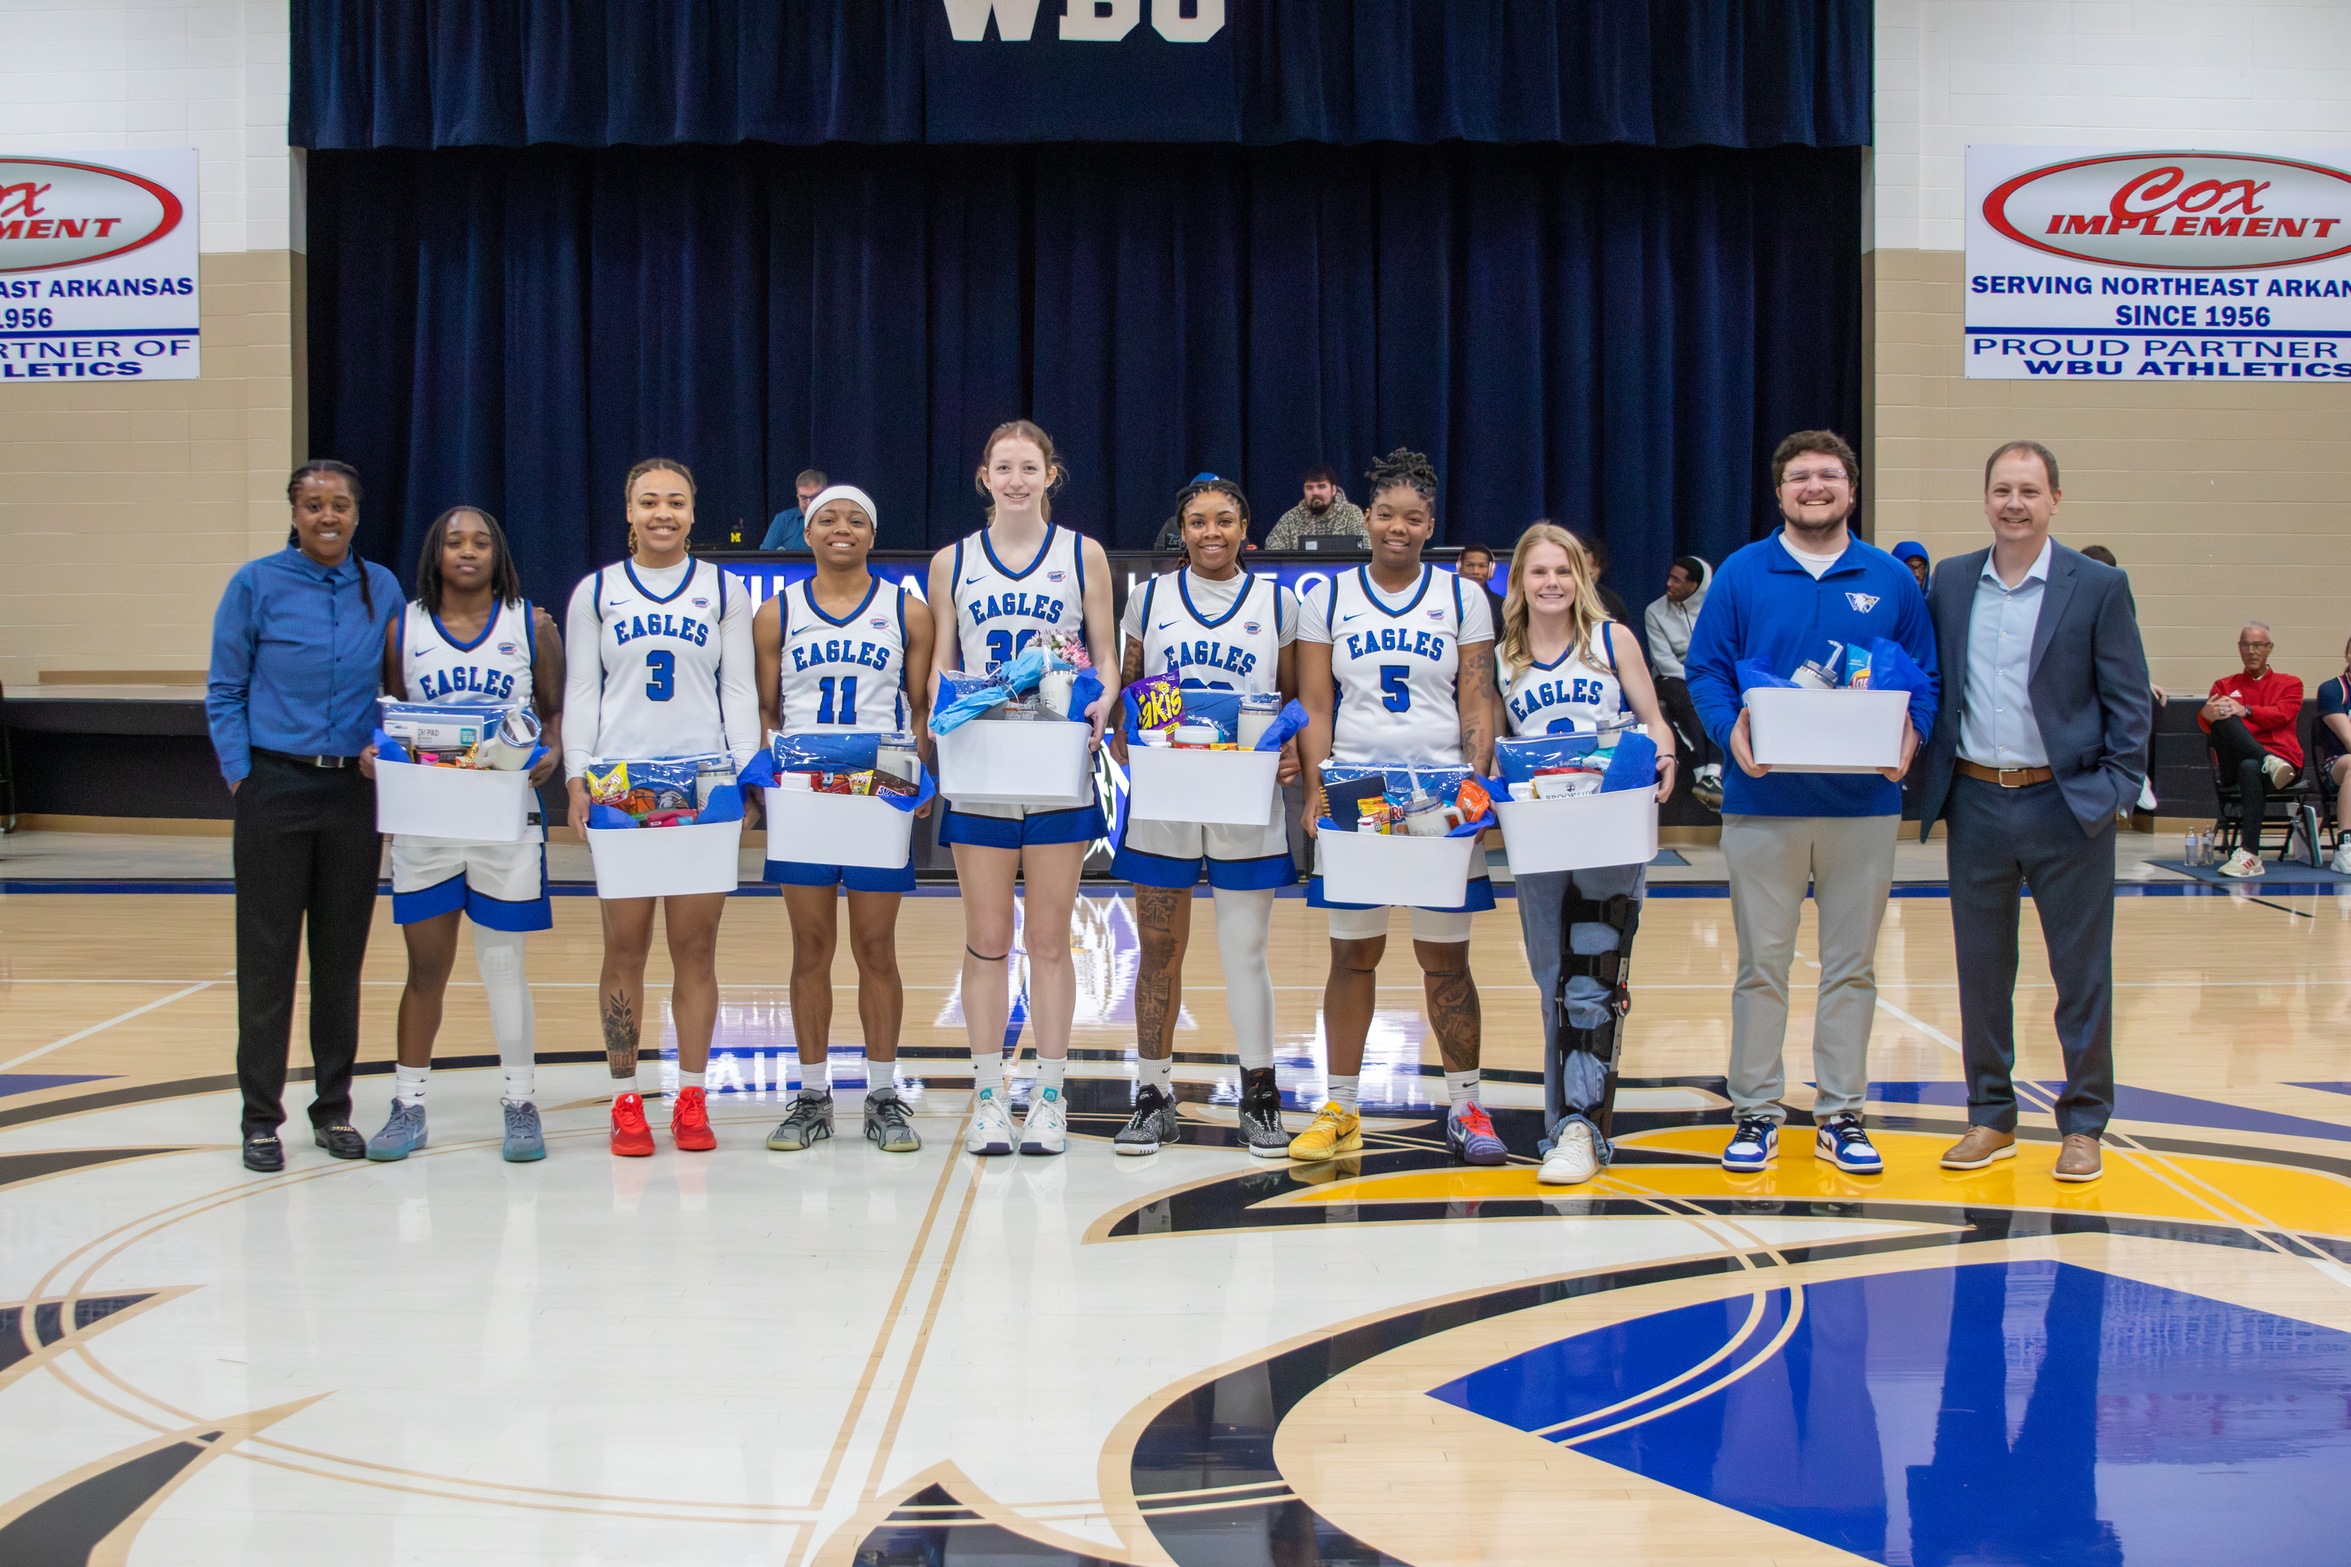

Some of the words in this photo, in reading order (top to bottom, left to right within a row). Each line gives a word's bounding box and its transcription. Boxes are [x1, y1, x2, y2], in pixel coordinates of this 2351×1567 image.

[943, 0, 1225, 42] WBU
[2109, 166, 2271, 220] Cox
[2045, 214, 2341, 238] IMPLEMENT
[49, 277, 193, 298] ARKANSAS
[1971, 275, 2092, 295] SERVING
[2102, 277, 2259, 297] NORTHEAST
[0, 307, 54, 329] 956
[2115, 304, 2197, 327] SINCE
[2205, 305, 2271, 328] 1956
[134, 340, 191, 357] OF
[1973, 338, 2130, 356] PROUD
[2144, 339, 2338, 358] PARTNER
[2024, 360, 2123, 376] WBU
[2136, 360, 2351, 378] ATHLETICS
[968, 592, 1064, 626] EAGLES
[613, 613, 709, 647] EAGLES
[1346, 628, 1445, 662] EAGLES
[791, 639, 890, 673] EAGLES
[1163, 640, 1257, 677] EAGLES
[419, 666, 515, 701] EAGLES
[645, 649, 676, 702] 3
[1379, 664, 1411, 713] 5
[816, 675, 858, 725] 11
[1509, 678, 1604, 723] EAGLES
